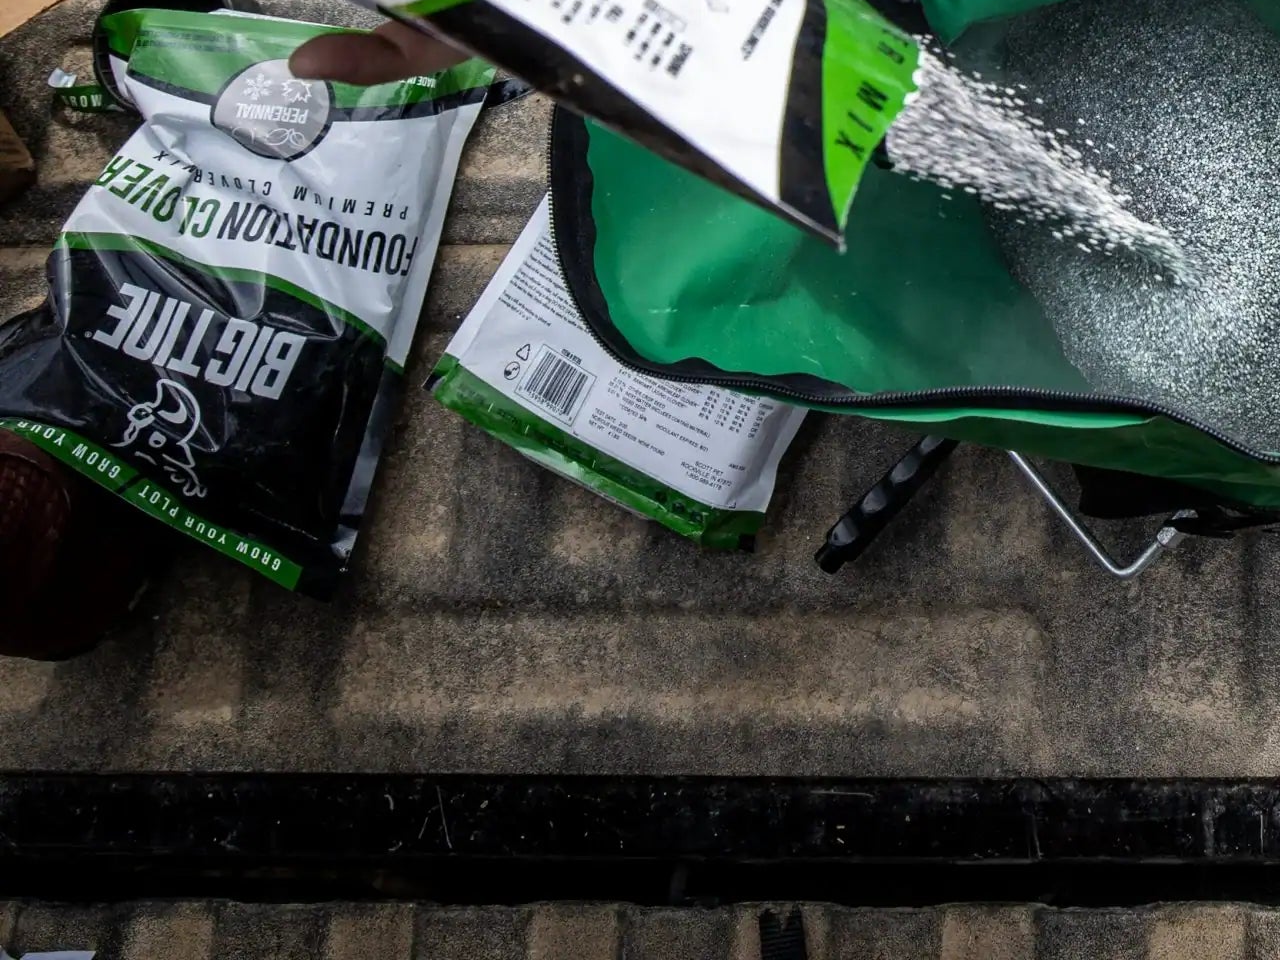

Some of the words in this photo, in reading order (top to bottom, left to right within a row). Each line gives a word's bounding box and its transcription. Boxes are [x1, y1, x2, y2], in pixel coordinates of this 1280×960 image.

[236, 102, 309, 124] PERENNIAL
[835, 80, 889, 162] MIX
[96, 155, 221, 239] CLOVER
[194, 170, 272, 197] CLOVER
[294, 184, 409, 220] PREMIUM
[217, 200, 419, 277] FOUNDATION
[17, 421, 67, 446] YOUR
[71, 446, 121, 479] GROW
[694, 459, 713, 473] SCOTT
[137, 484, 180, 518] PLOT
[184, 516, 227, 545] YOUR
[235, 541, 282, 571] GROW
